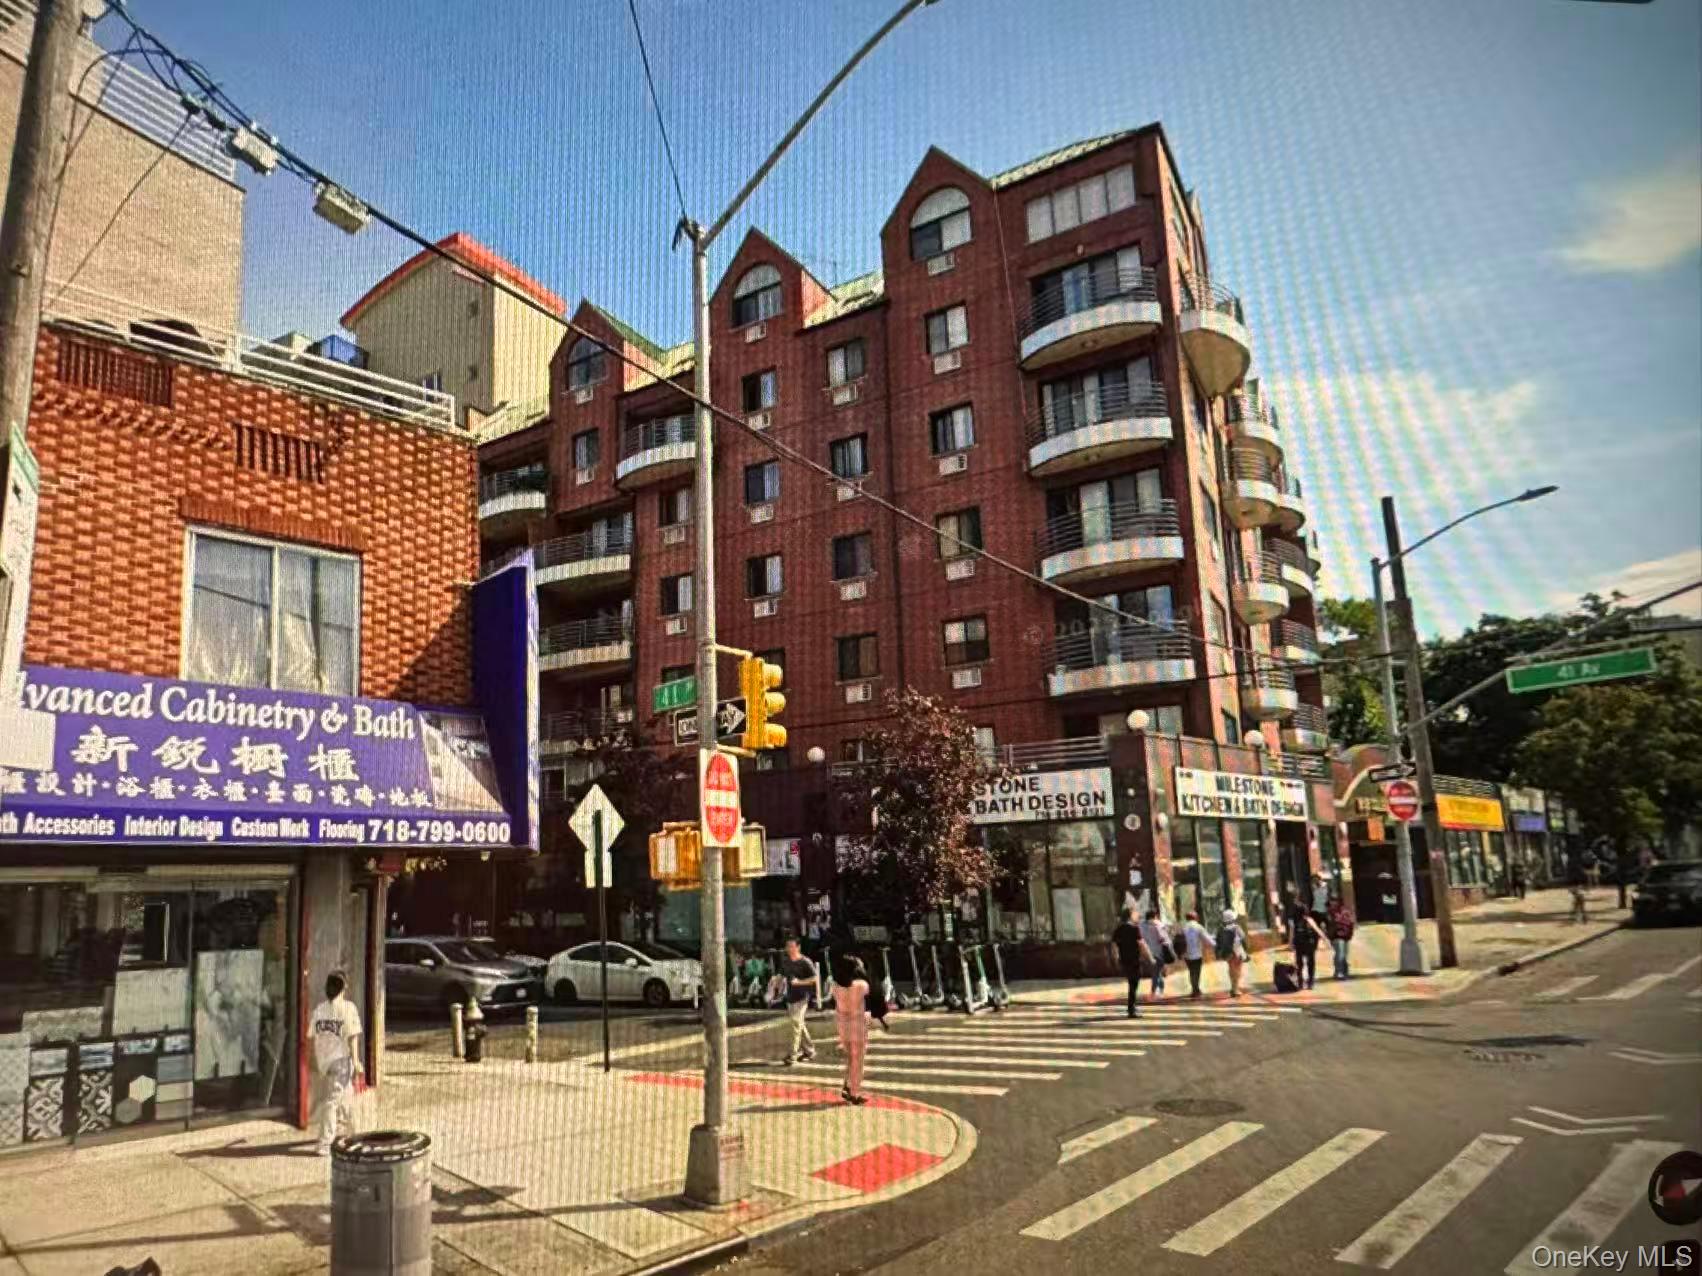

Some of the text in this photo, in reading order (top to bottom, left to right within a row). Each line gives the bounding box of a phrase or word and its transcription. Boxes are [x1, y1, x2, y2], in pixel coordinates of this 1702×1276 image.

[1557, 664, 1576, 679] 41
[160, 686, 316, 741] Cabinetry
[321, 702, 348, 733] &
[352, 704, 416, 740] Bath
[1216, 775, 1275, 797] MILESTONE
[974, 797, 1023, 814] BATH
[1028, 790, 1106, 811] DESIGN
[1182, 793, 1233, 813] KITCHEN
[22, 811, 116, 836] Accessories
[125, 815, 177, 837] Interior
[179, 815, 224, 842] Design
[231, 816, 278, 837] Custom
[279, 818, 311, 838] Work
[318, 819, 365, 843] Flooring
[367, 818, 511, 843] 718-799-0600
